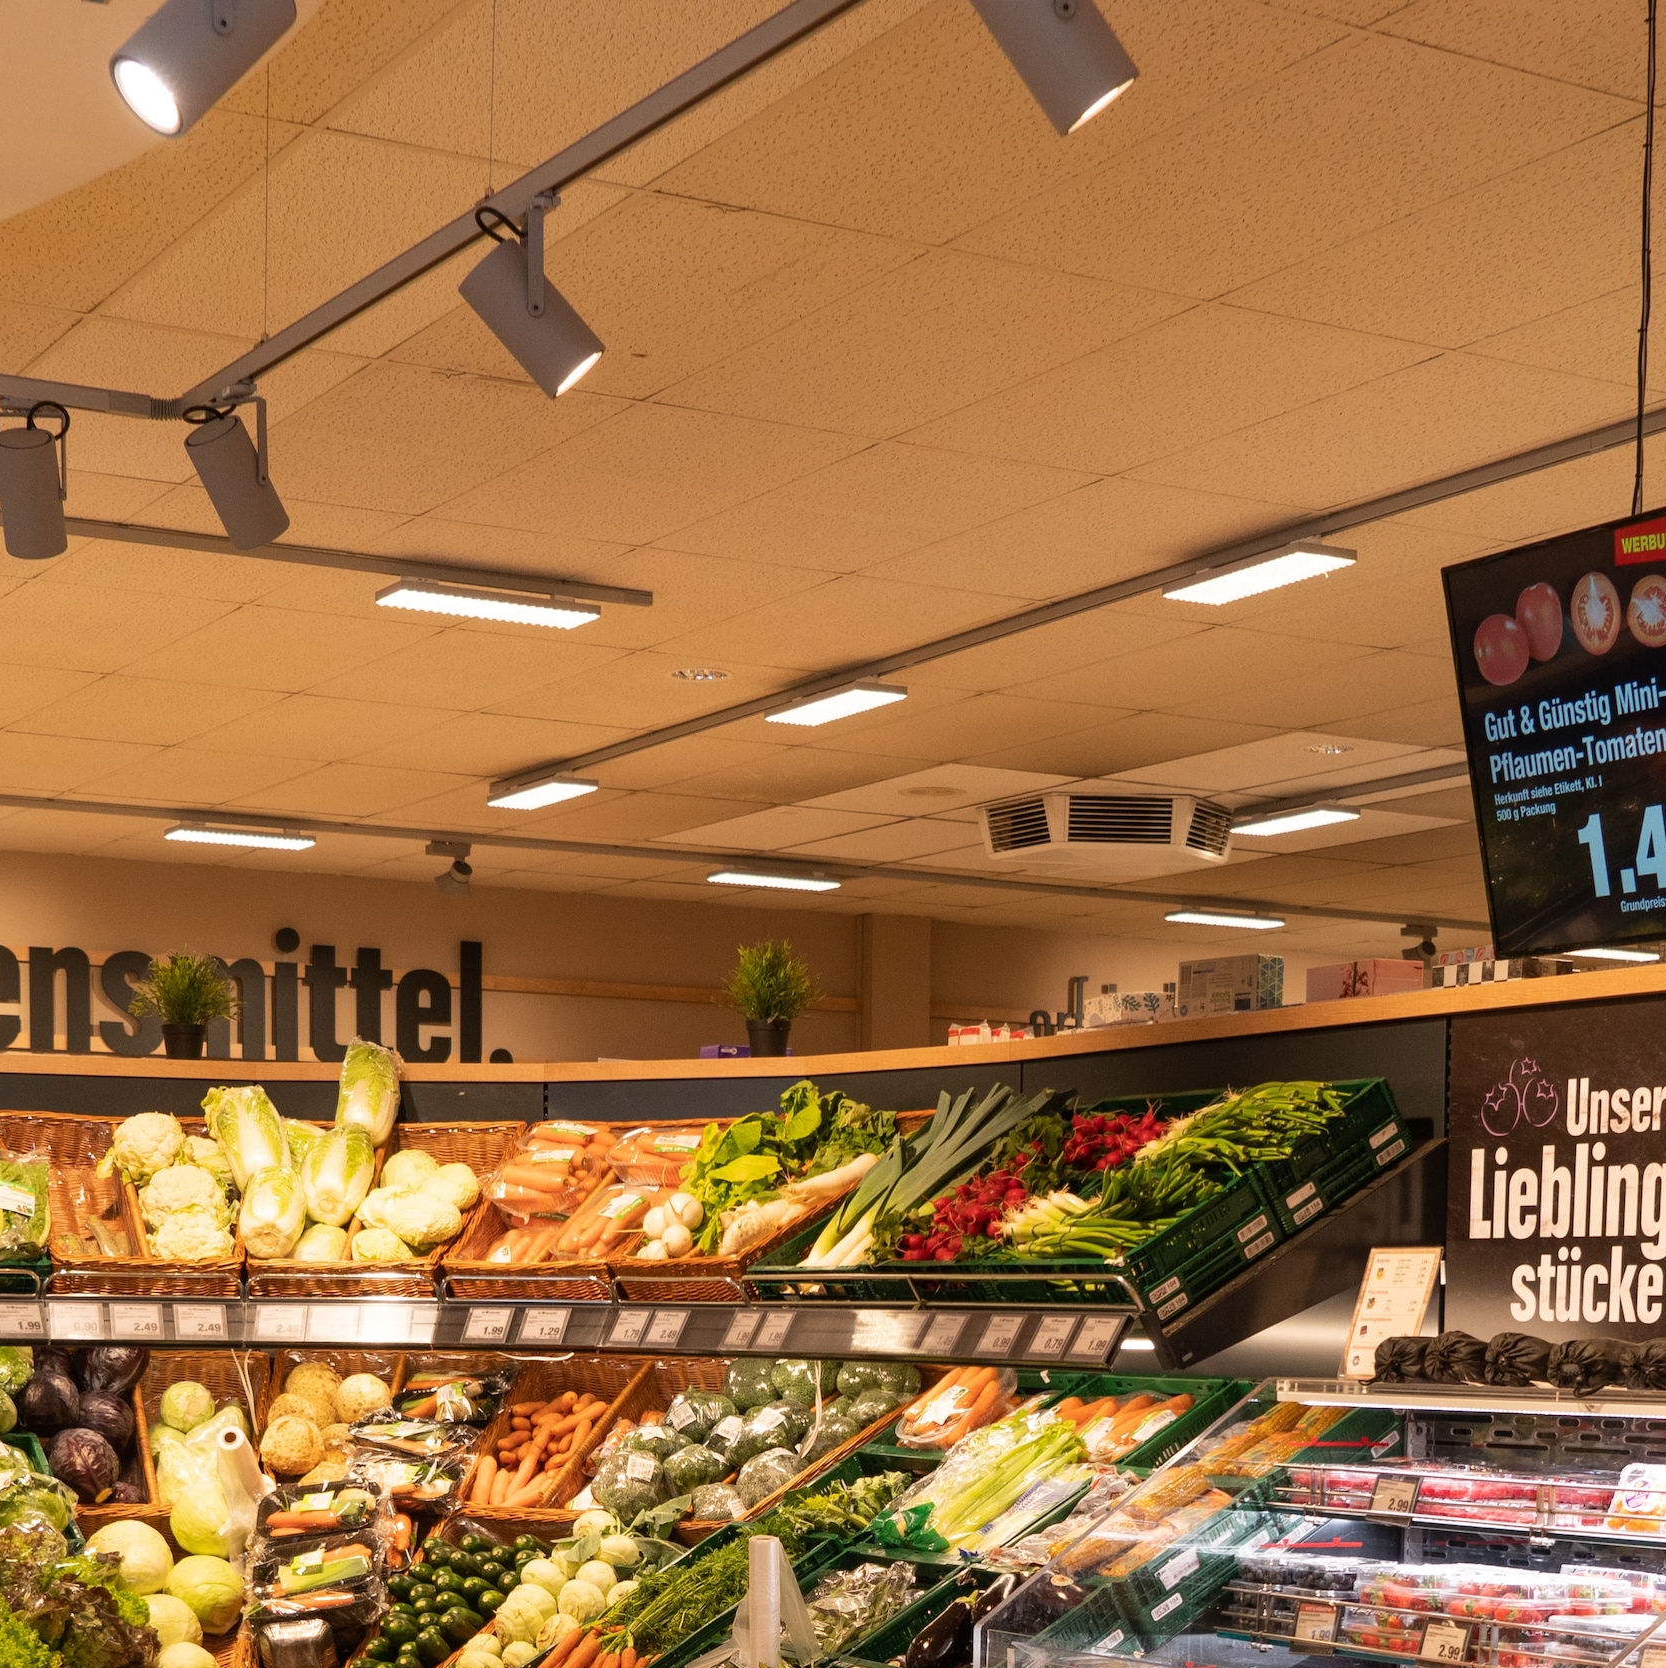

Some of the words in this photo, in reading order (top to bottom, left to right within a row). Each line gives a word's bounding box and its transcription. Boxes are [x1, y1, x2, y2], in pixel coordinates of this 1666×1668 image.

[1484, 711, 1517, 743] Gut
[1520, 705, 1535, 734] &
[1538, 689, 1611, 735] Günstig
[1493, 790, 1529, 808] Herkunft
[1531, 786, 1553, 802] siehe
[1554, 781, 1585, 798] Etikett,
[1586, 778, 1598, 793] Kl.
[1496, 809, 1511, 823] 500
[1511, 811, 1518, 824] g
[1520, 802, 1557, 819] Packung
[1510, 1247, 1664, 1325] stücke
[17, 1321, 41, 1330] 1.99
[133, 1322, 158, 1331] 2.49
[197, 1323, 221, 1332] 2.49
[483, 1326, 503, 1336] 1.99
[539, 1327, 560, 1336] 1.29
[1388, 1498, 1409, 1513] 2.99
[1438, 1644, 1461, 1660] 2.99
